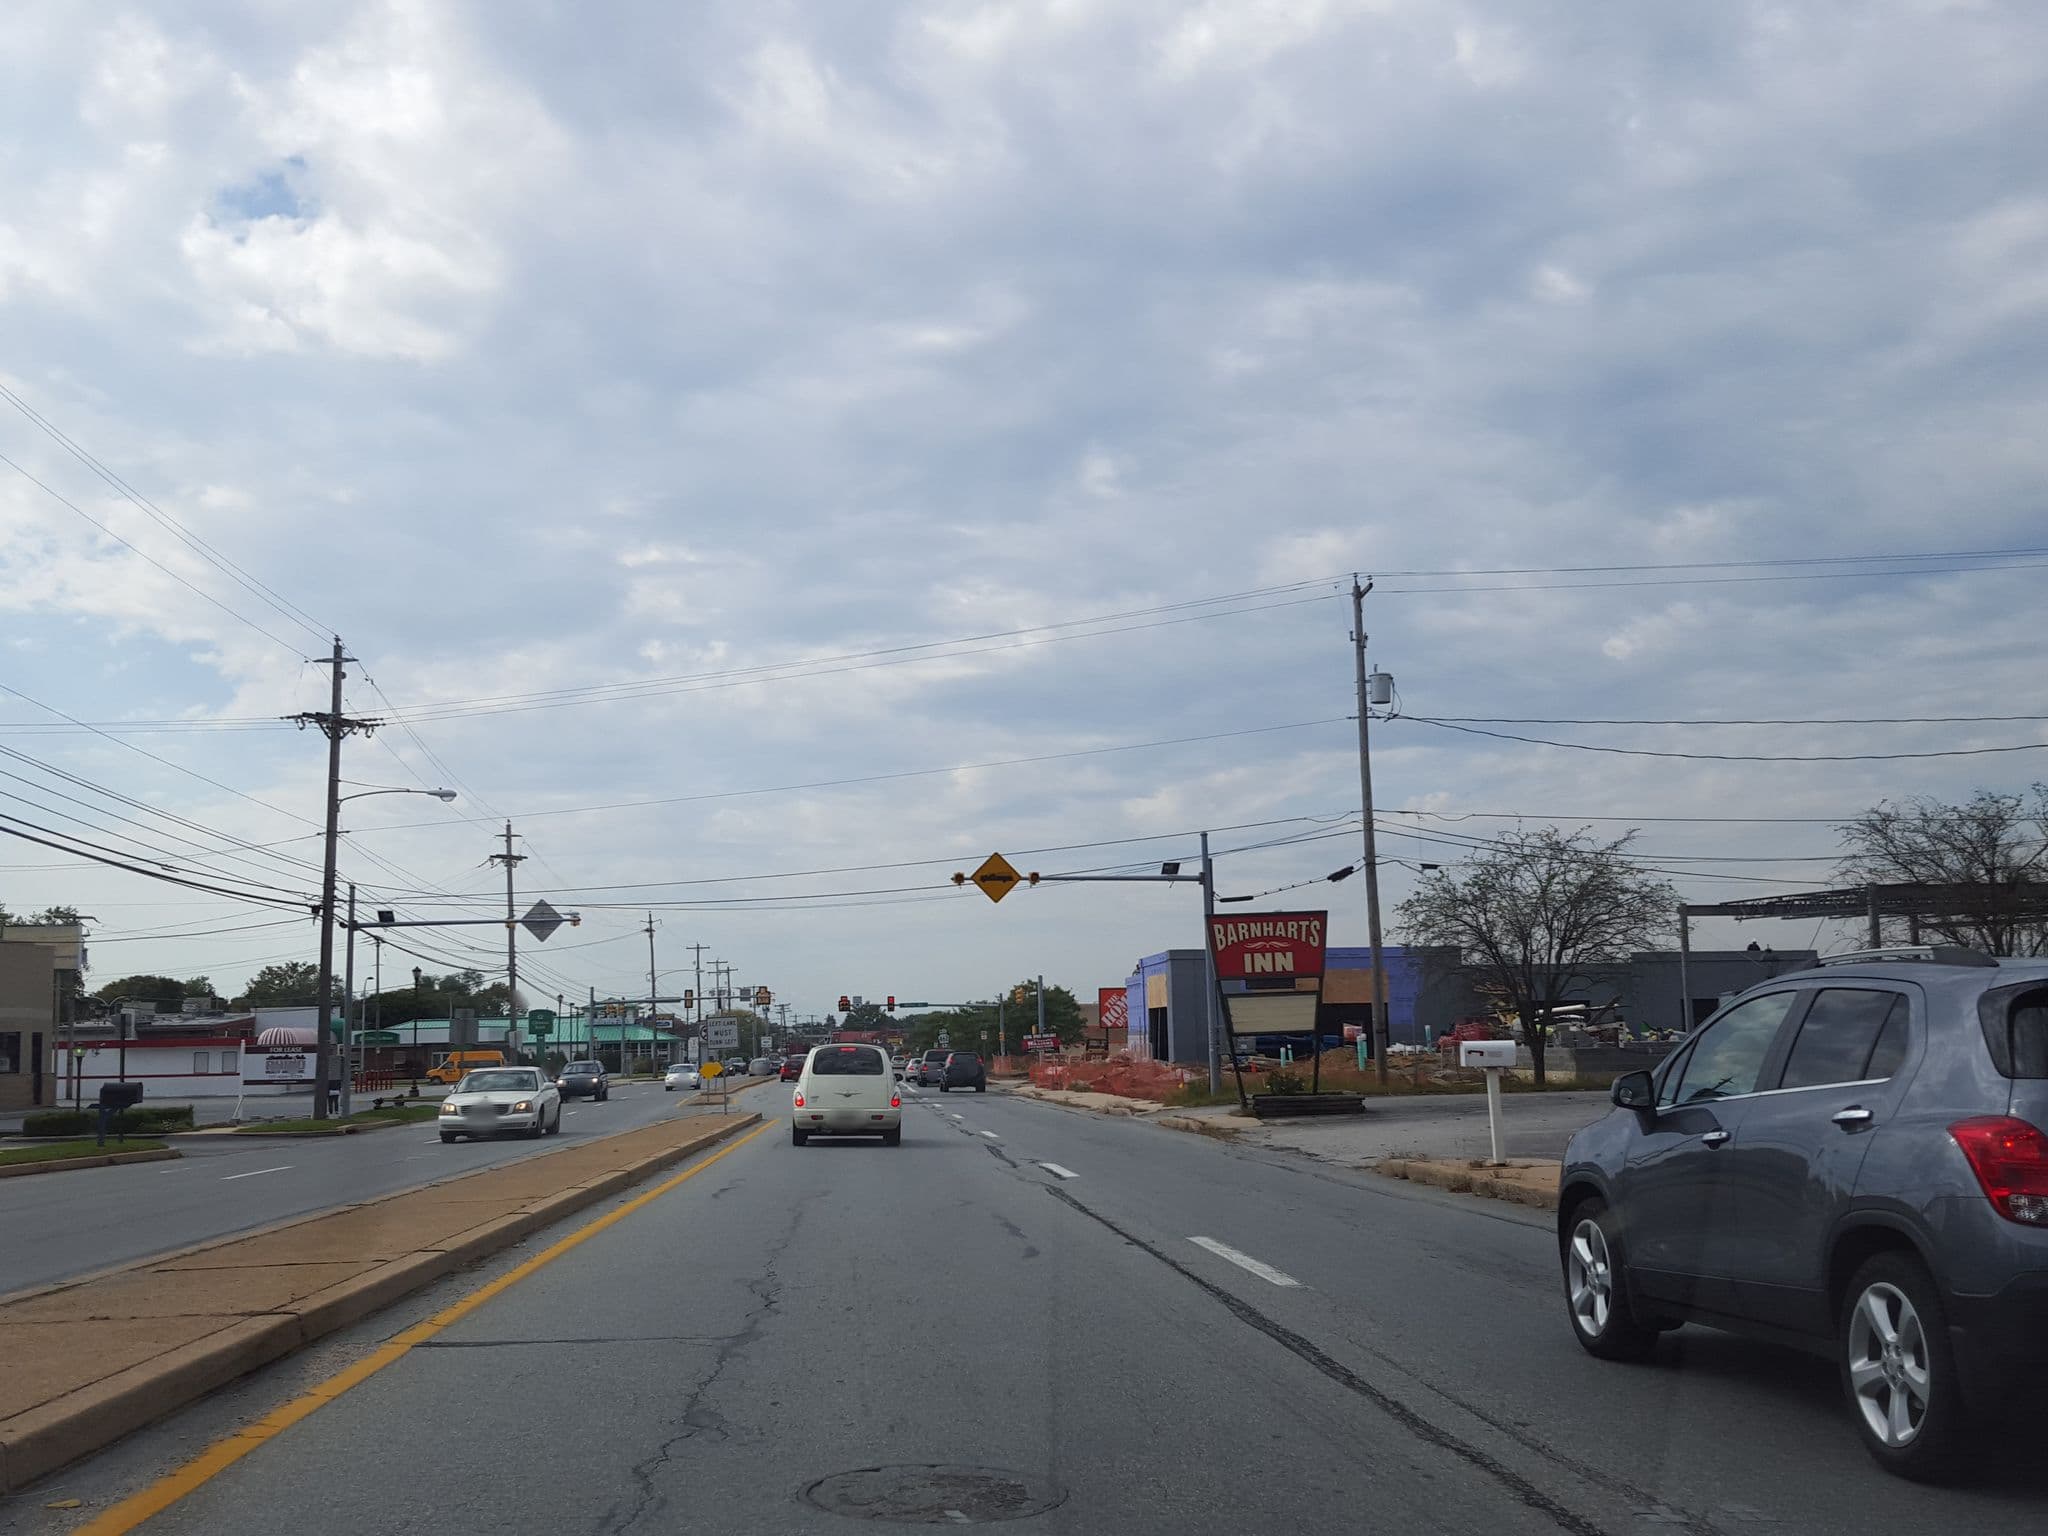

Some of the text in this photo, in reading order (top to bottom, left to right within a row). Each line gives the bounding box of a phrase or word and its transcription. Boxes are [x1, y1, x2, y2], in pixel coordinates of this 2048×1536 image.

[1213, 917, 1321, 952] BARNHART'S
[1243, 951, 1294, 974] INN
[1104, 993, 1120, 1008] THE
